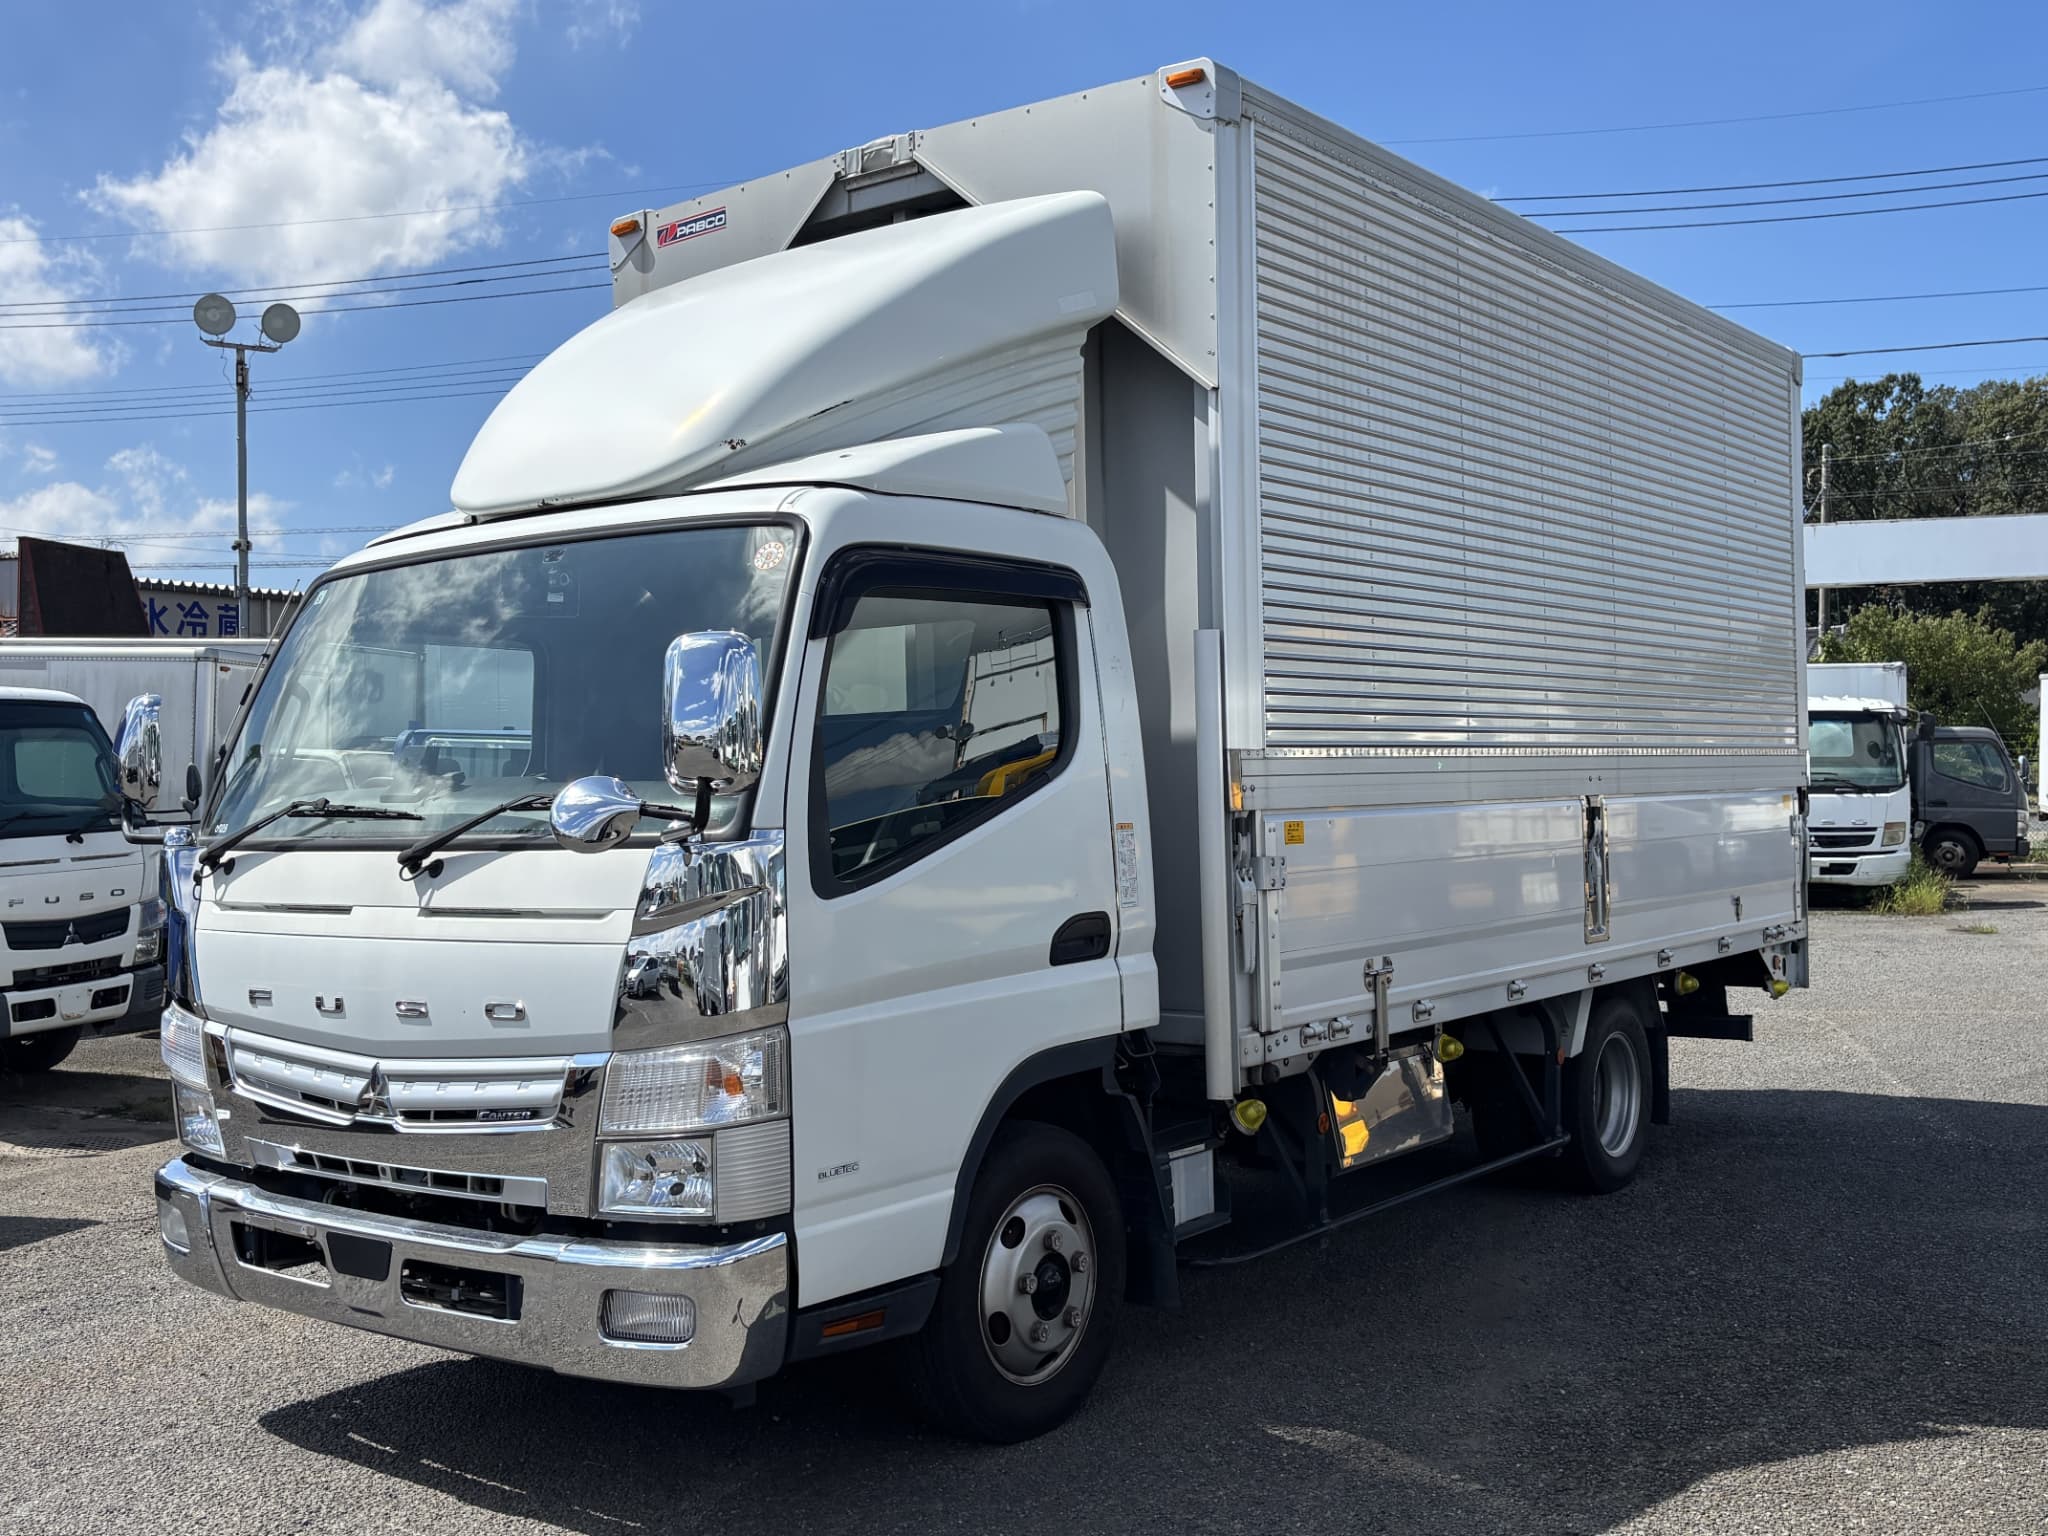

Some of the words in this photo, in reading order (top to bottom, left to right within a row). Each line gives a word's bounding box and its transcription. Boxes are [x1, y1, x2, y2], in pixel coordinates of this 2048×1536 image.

[676, 213, 726, 238] PABCO
[8, 888, 126, 908] FUSO
[249, 988, 526, 1022] FUSO
[479, 1111, 531, 1121] CANTER
[817, 1161, 860, 1180] BLUETEC
